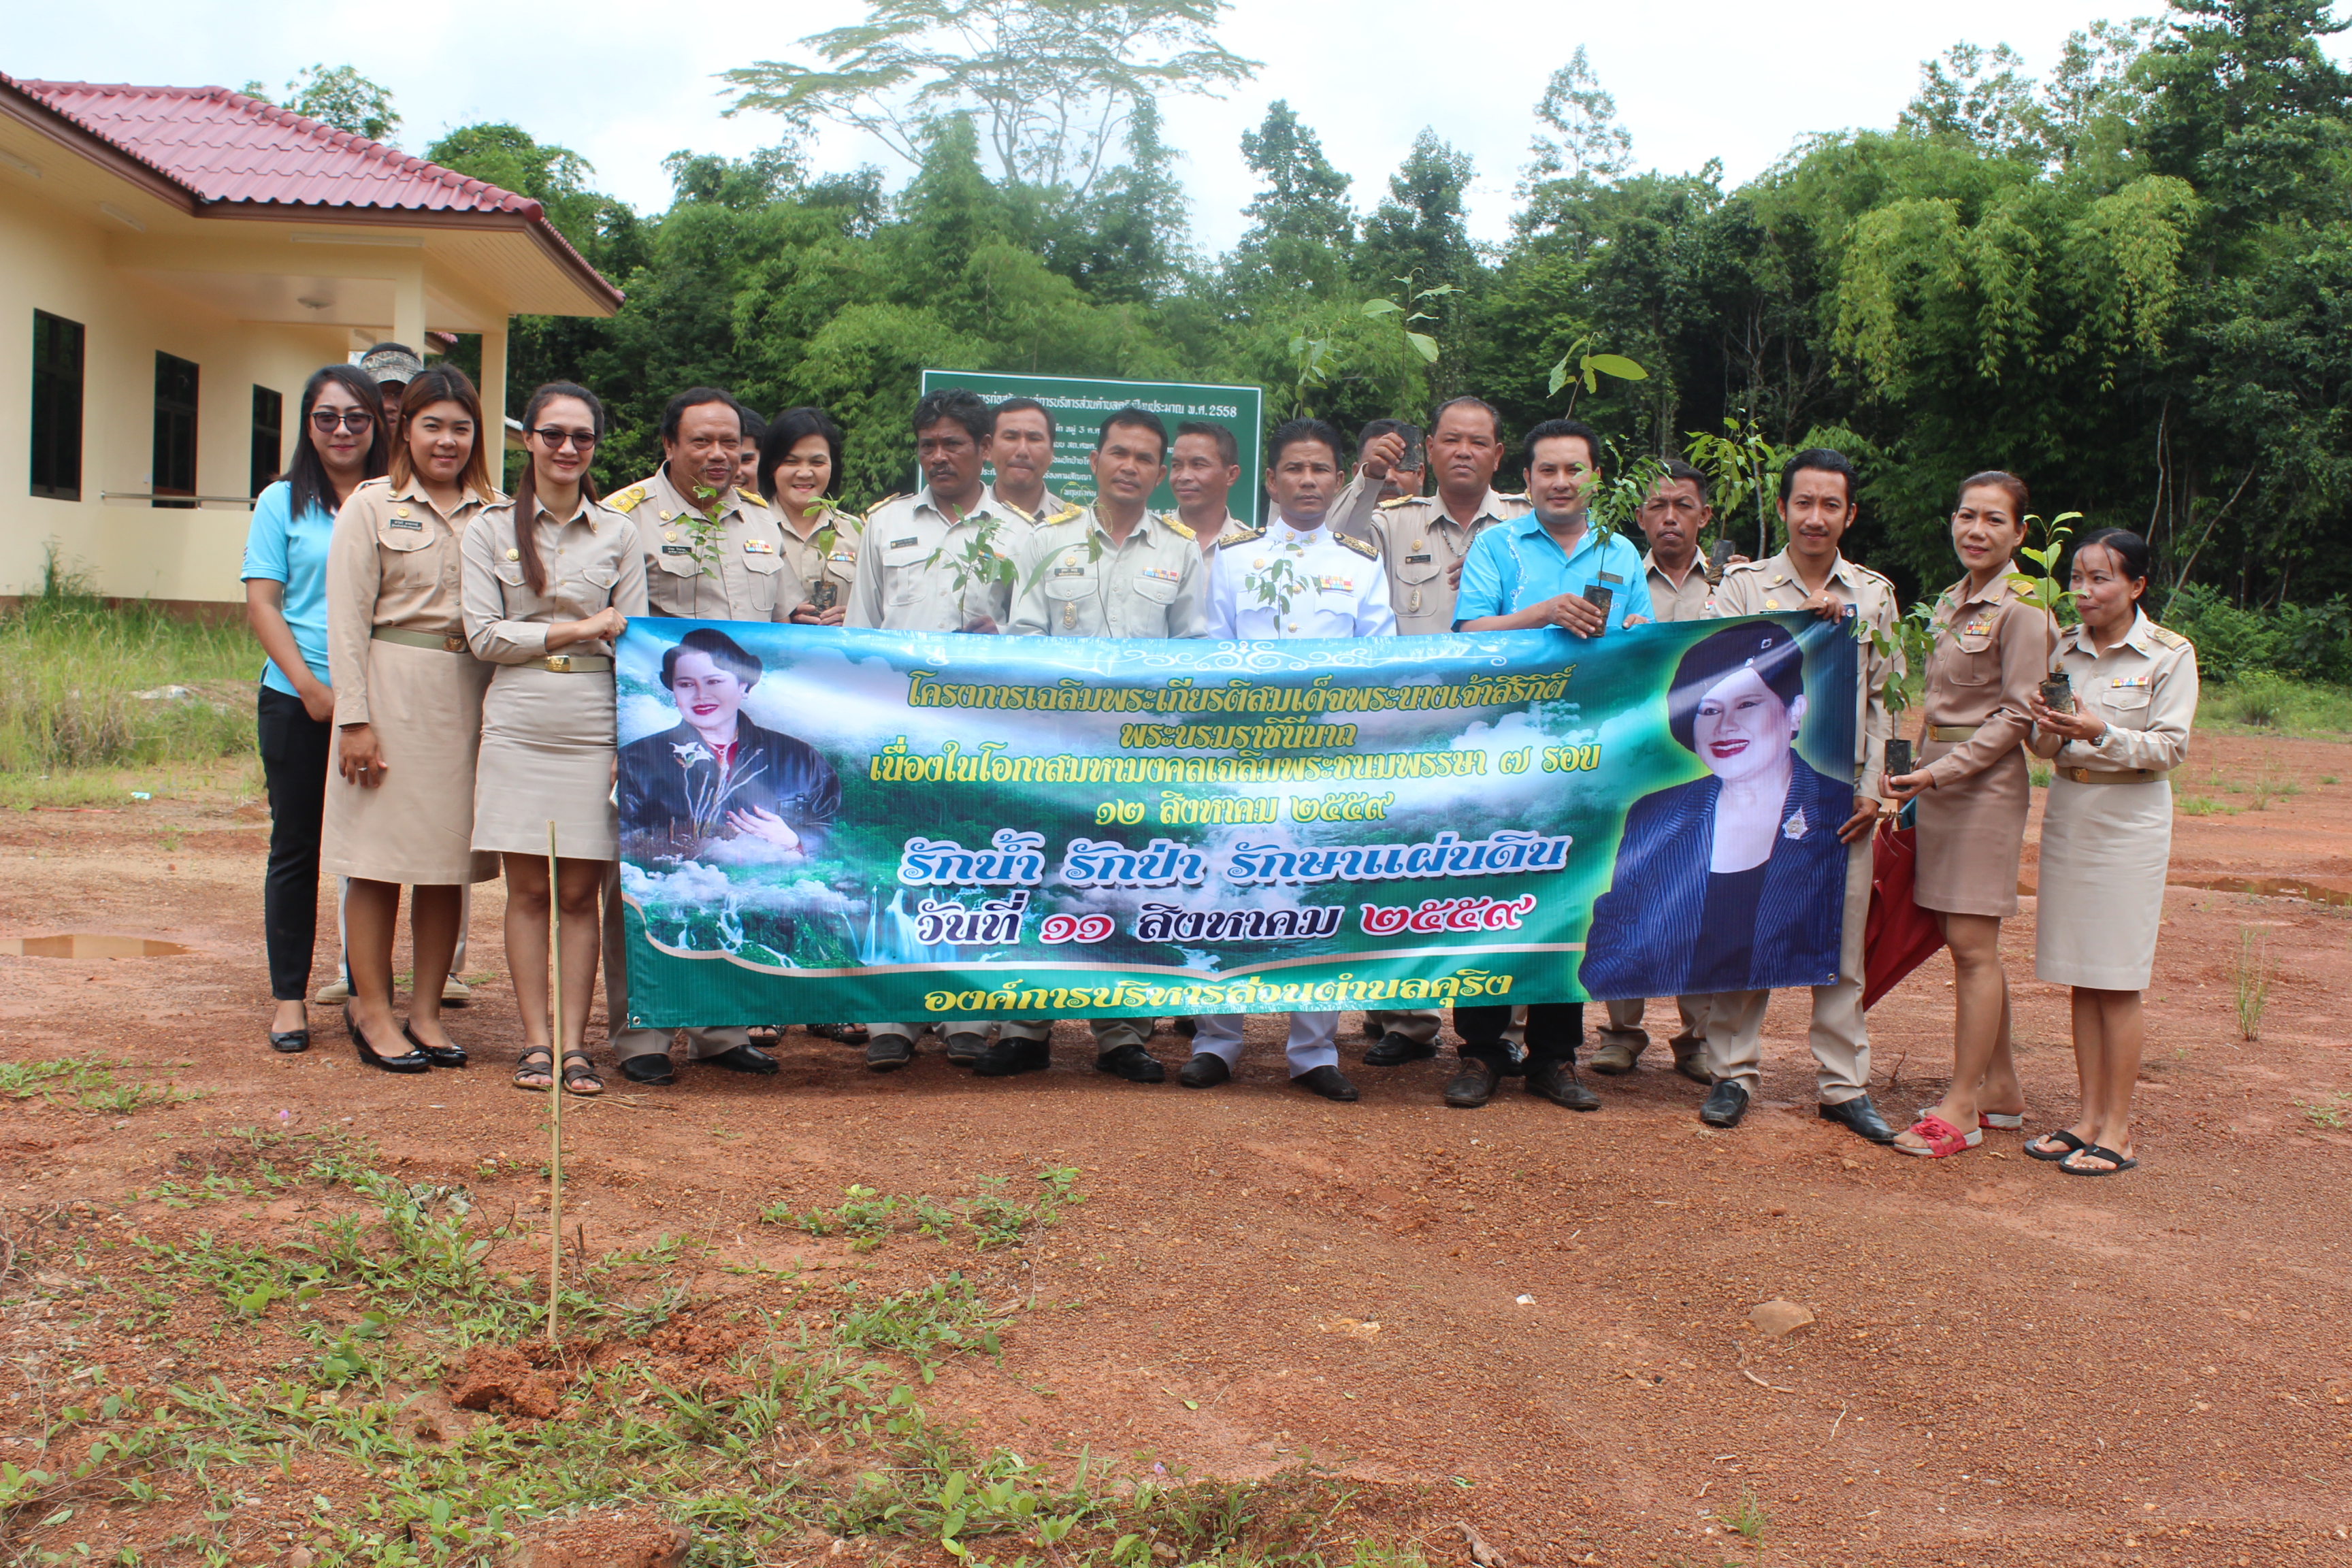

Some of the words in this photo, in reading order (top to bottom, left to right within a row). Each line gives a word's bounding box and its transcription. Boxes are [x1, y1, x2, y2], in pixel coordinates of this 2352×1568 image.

[1079, 425, 1085, 434] 3
[1188, 404, 1237, 418] พ.ศ.2558
[1042, 470, 1092, 480] ร่องตามสัญญา
[907, 664, 1577, 713] โครงการเฉลิมพระเกียรติสมเด็จพระนางเจ้าสิริกิติ์
[1120, 715, 1357, 749] พระบรมราชินีนาถ
[870, 735, 1488, 783] เนื่องในโอกาสมหามงคลเฉลิมพระชนมพรรษา
[1499, 747, 1534, 775] ๗
[1541, 744, 1602, 774] รอบ
[1095, 798, 1146, 826] ๑๒
[1159, 790, 1278, 824] สิงหาคม
[1290, 791, 1394, 823] ๒๕๕๙
[902, 832, 1043, 881] รักน้ำ
[1063, 840, 1203, 881] รักป่า
[1225, 834, 1568, 879] รักษาแผ่นดิน
[917, 892, 1029, 942] วันที่
[1041, 915, 1113, 941] ๑๑
[1139, 902, 1341, 940] สิงหาคม
[1362, 895, 1535, 934] ๒๕๕๙
[924, 968, 1514, 1011] องค์การบริหารส่วนตำบลคุริง
